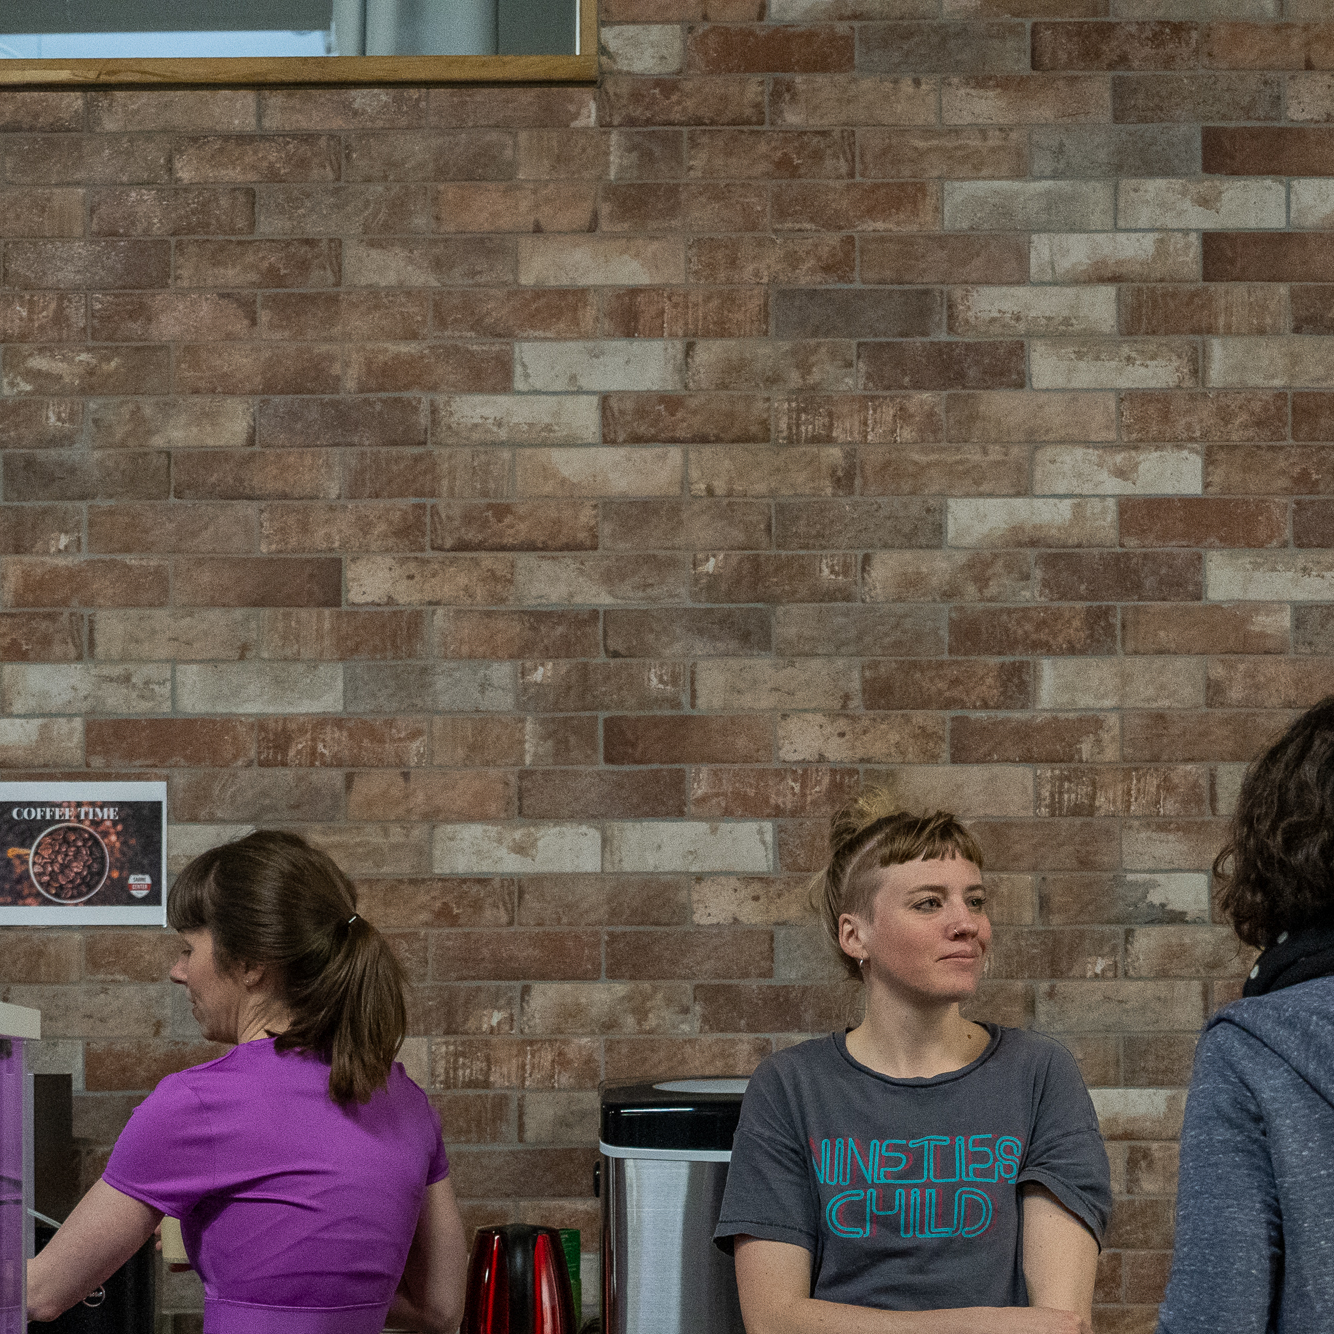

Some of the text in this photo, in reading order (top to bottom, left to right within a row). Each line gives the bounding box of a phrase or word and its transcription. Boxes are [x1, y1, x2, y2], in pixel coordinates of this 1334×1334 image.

[11, 806, 119, 820] COFFEE TIME
[825, 1187, 998, 1239] CHILD
